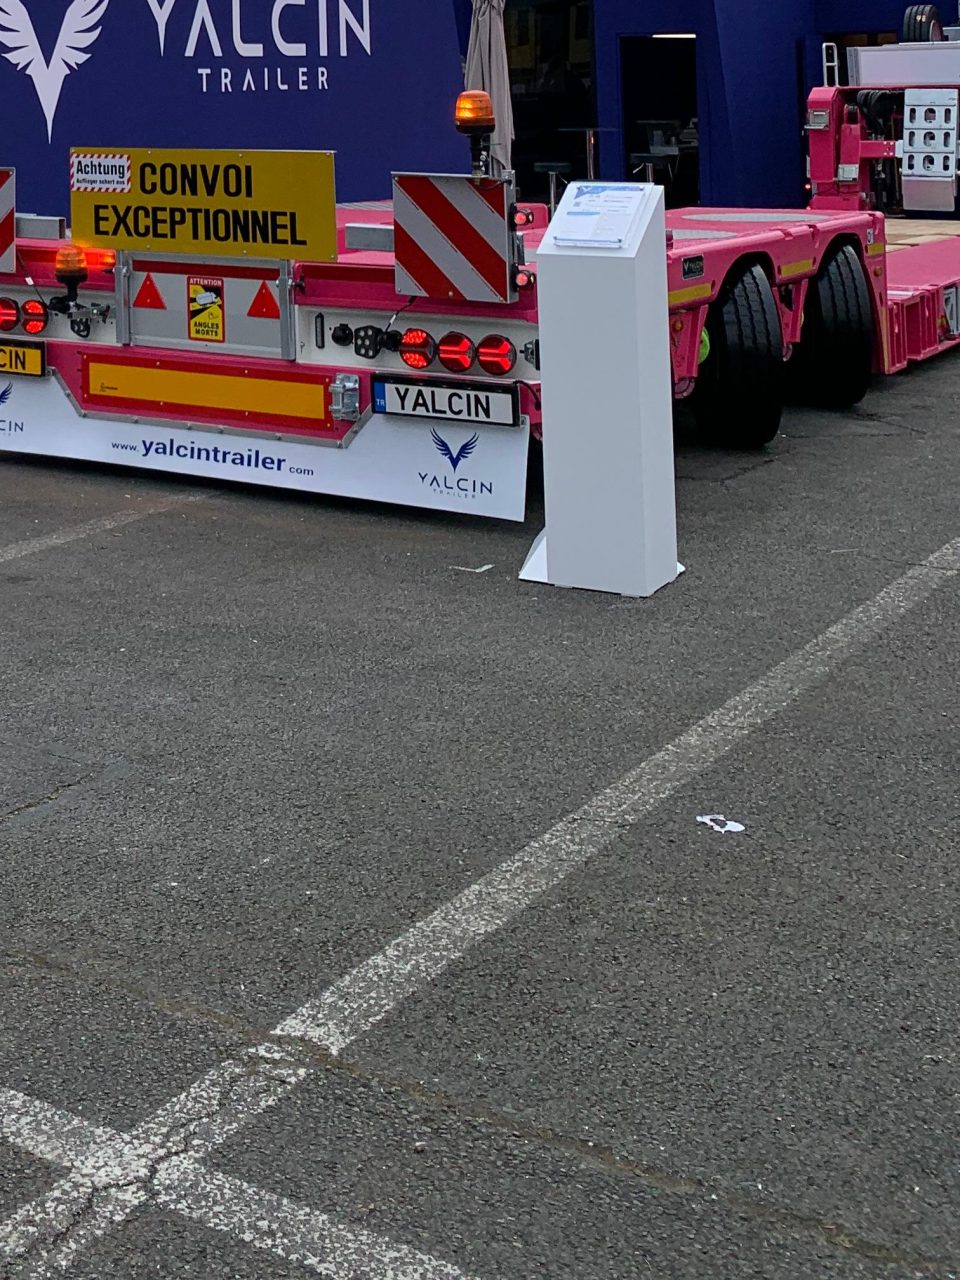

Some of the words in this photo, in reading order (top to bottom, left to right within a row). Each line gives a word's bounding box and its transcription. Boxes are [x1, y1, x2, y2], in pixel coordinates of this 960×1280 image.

[198, 67, 328, 92] TRAILER
[76, 160, 125, 179] Achtung
[140, 162, 253, 198] CONVOI
[94, 204, 307, 246] EXCEPTIONNEL
[190, 278, 222, 287] ATTENTION
[194, 320, 220, 330] ANGLES
[195, 328, 219, 337] MORTS
[376, 398, 385, 407] TR
[395, 387, 491, 418] YALCIN
[418, 472, 493, 494] YALCIN
